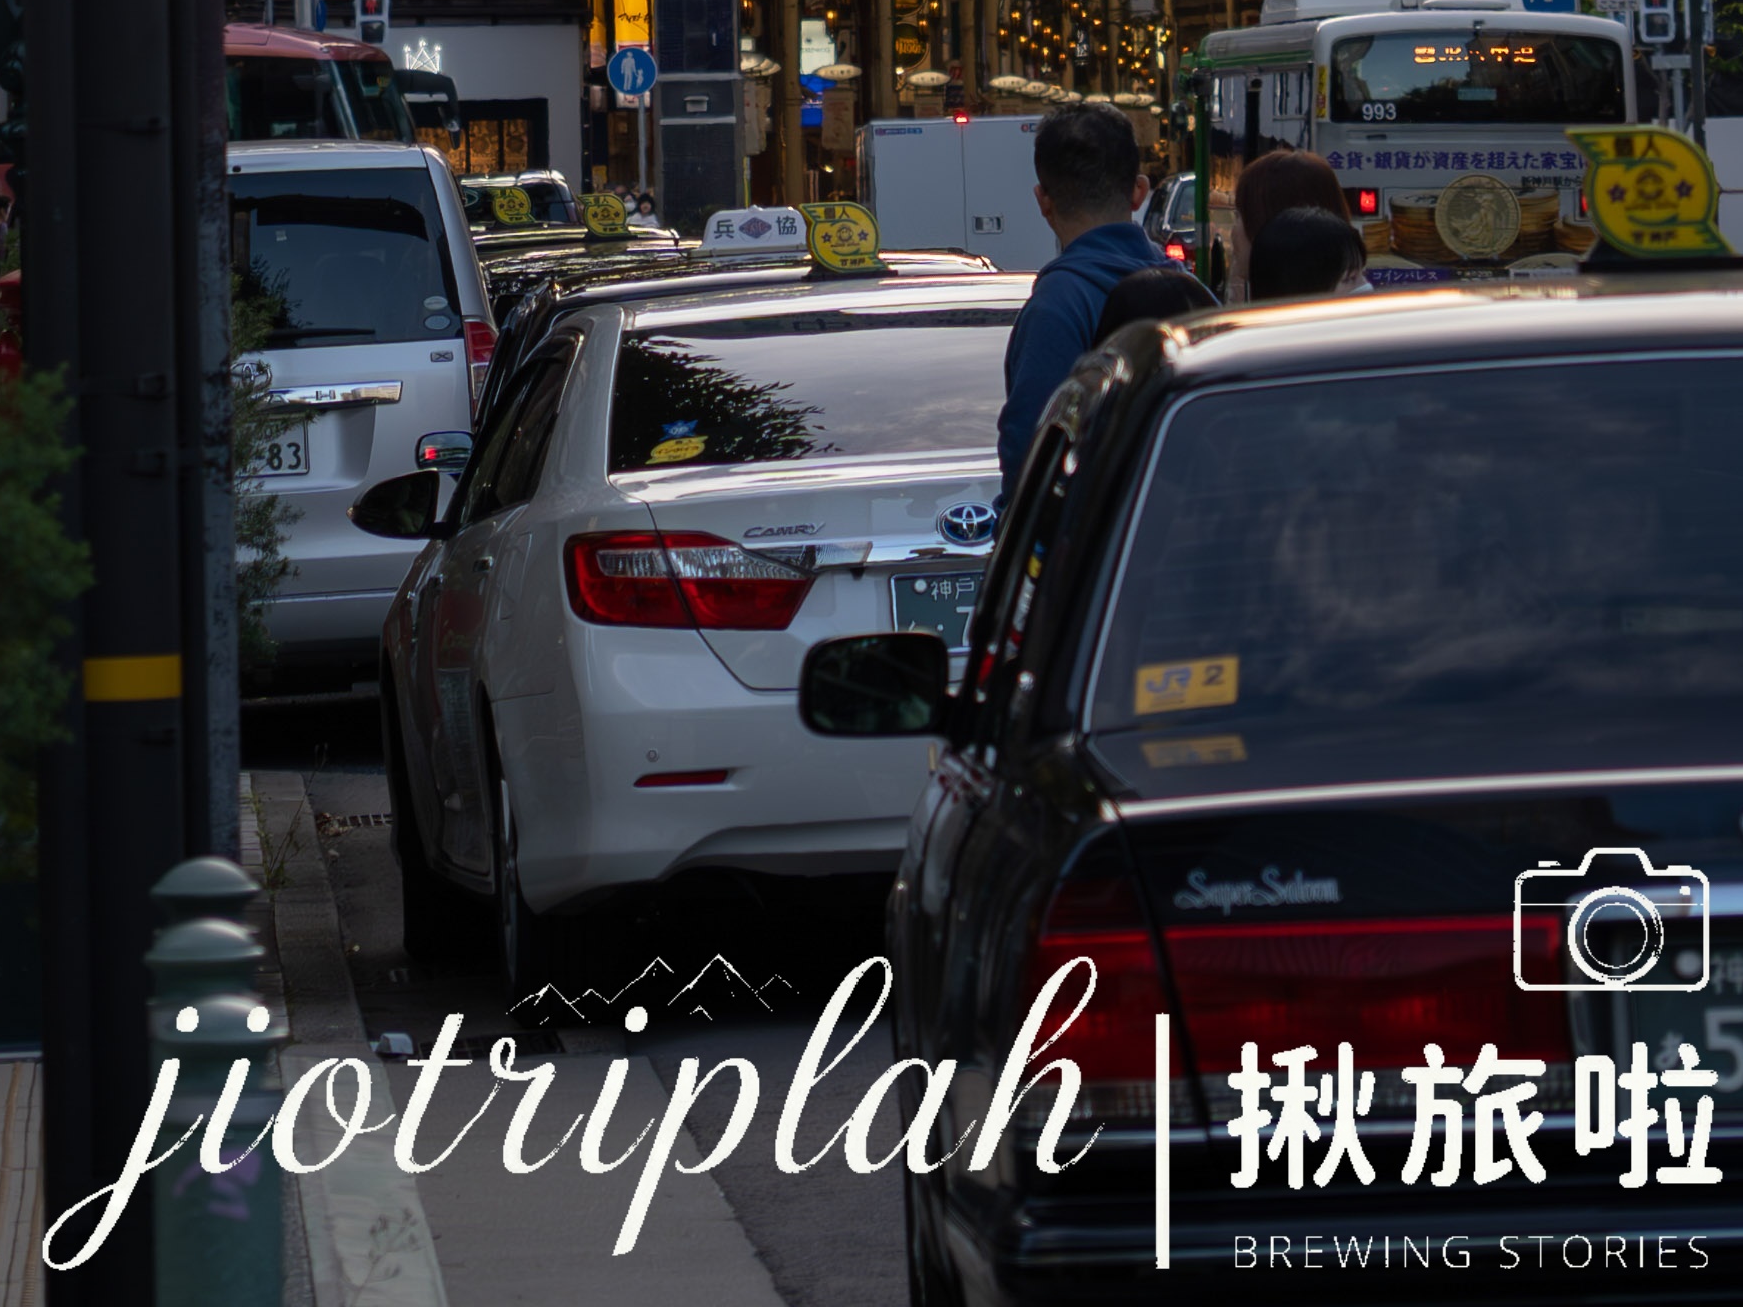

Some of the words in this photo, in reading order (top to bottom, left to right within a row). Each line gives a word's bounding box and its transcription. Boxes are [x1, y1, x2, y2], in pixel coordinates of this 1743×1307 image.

[1361, 102, 1398, 122] 993
[713, 219, 736, 239] 兵
[777, 215, 799, 236] 協
[743, 522, 826, 538] CAMRY
